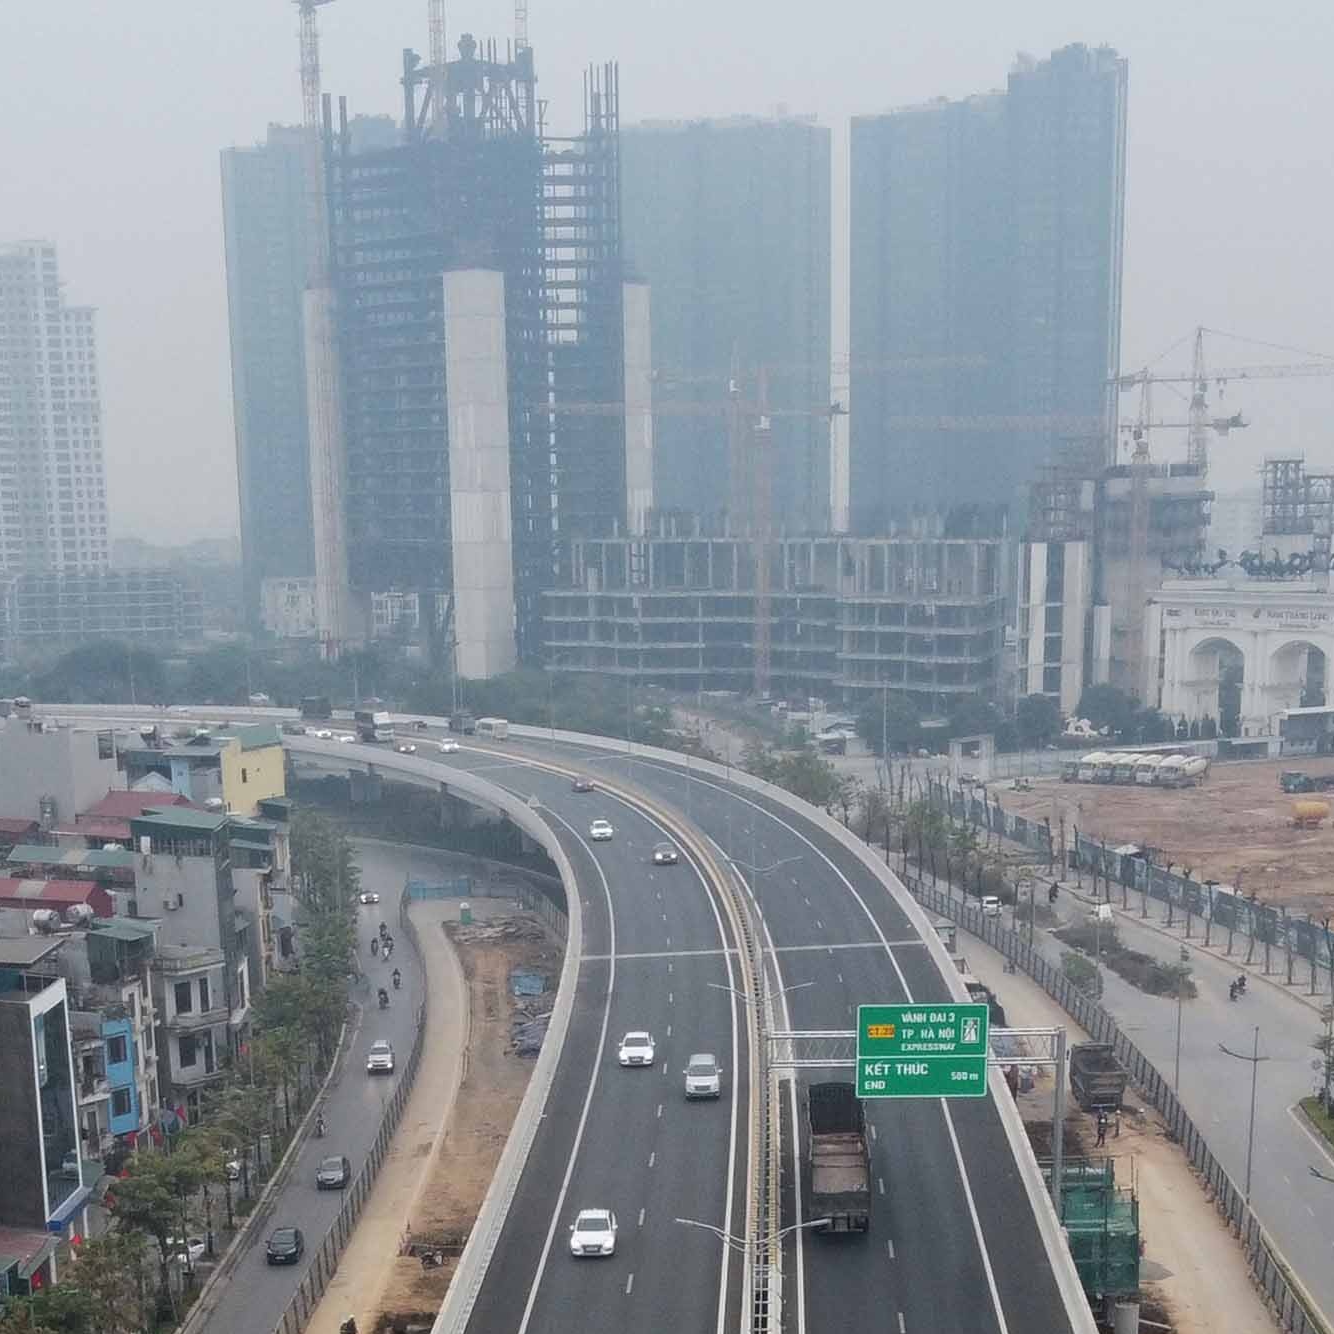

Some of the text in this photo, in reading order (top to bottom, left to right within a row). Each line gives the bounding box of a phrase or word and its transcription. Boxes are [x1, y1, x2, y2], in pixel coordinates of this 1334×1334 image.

[901, 1011, 927, 1023] VÀNH
[948, 1012, 956, 1022] 3
[921, 1027, 934, 1039] HÀ
[938, 1027, 955, 1040] NỘI
[901, 1043, 956, 1051] EXPRESSWAY
[865, 1061, 929, 1075] KẾT THÚC
[950, 1072, 979, 1081] 500 m
[864, 1080, 886, 1090] END
